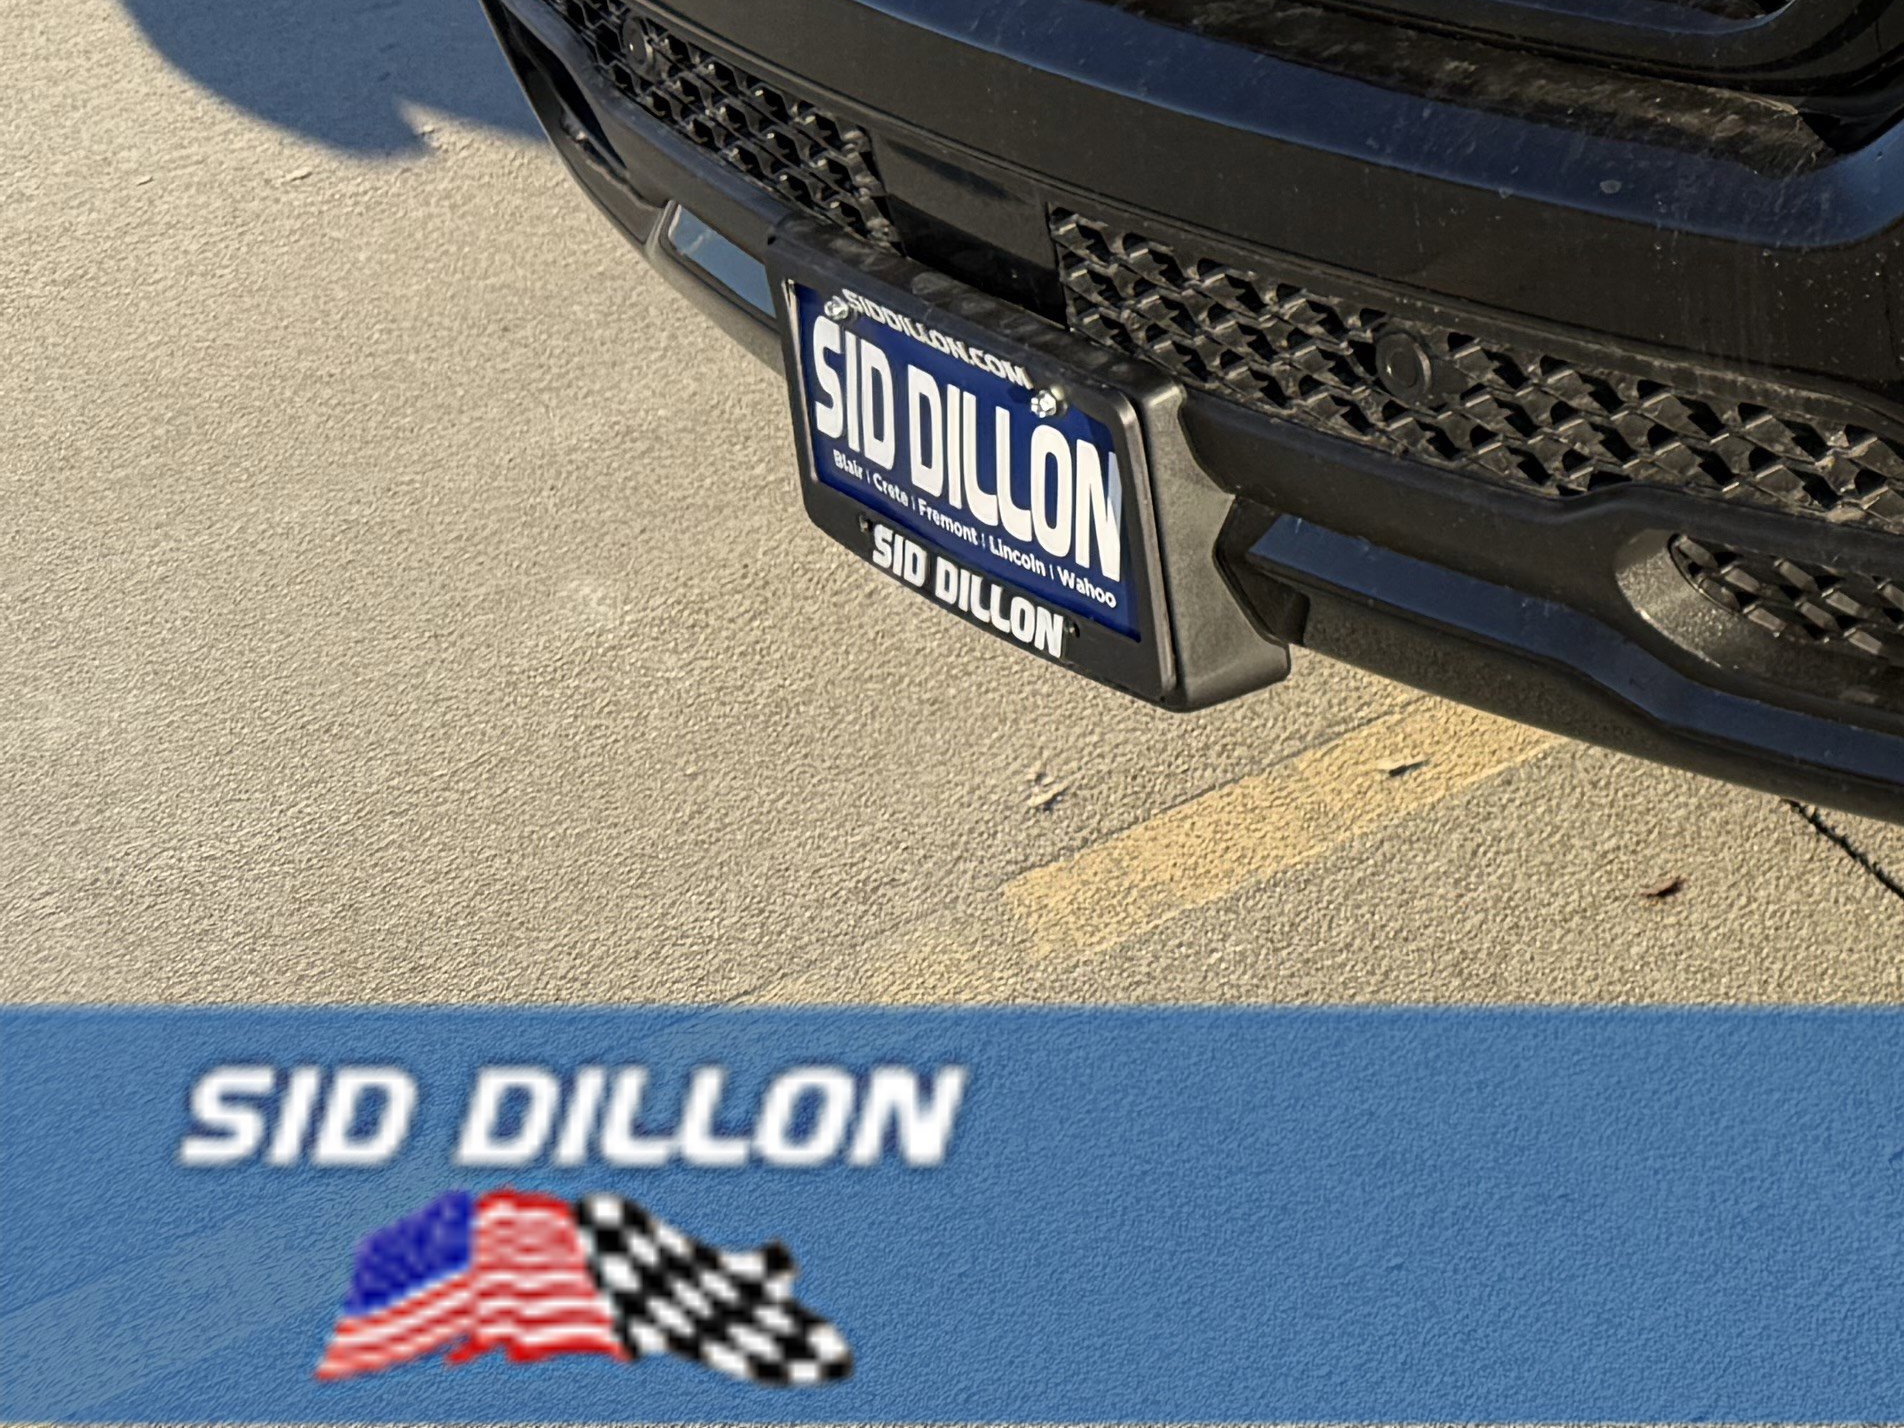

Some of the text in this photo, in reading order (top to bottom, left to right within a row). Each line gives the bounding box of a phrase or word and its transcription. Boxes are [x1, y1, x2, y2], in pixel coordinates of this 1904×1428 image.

[842, 288, 1035, 391] SIDDILLON.COM
[812, 314, 1123, 583] SID DILLON
[832, 448, 1118, 609] Blair Crete Fremont Lincoln Wahoo
[872, 523, 1065, 660] SID DILLON
